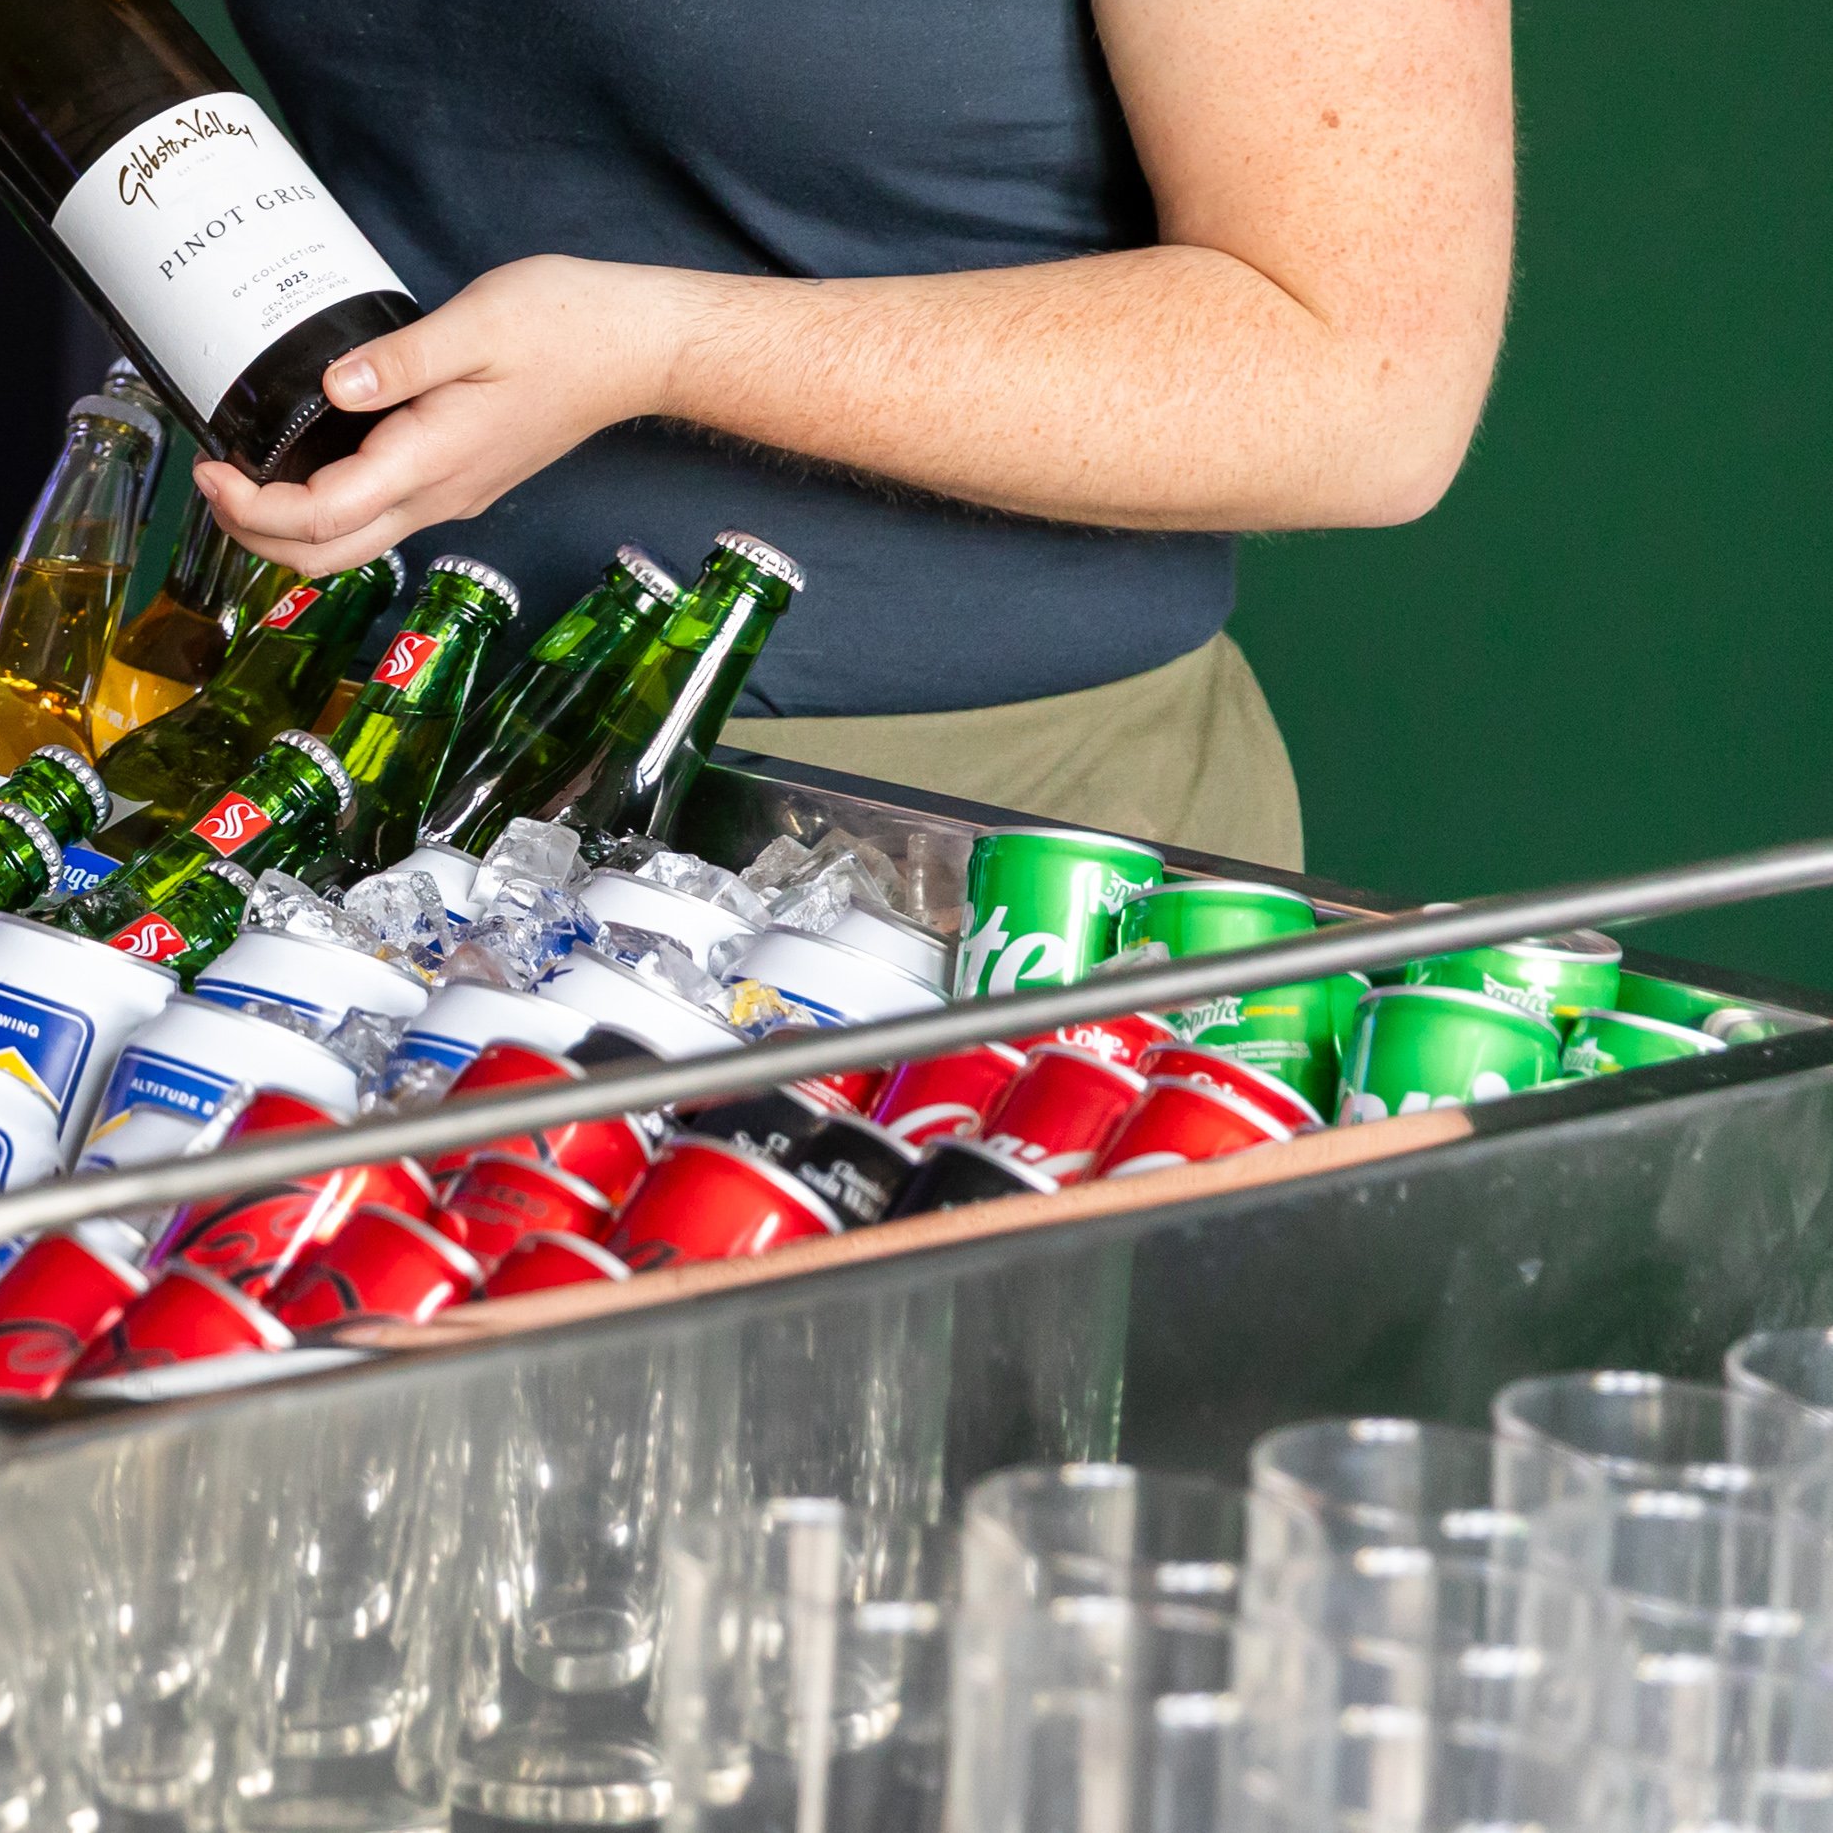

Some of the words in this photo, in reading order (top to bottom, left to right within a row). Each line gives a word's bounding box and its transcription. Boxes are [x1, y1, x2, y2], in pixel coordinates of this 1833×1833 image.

[175, 108, 260, 150] Valley
[158, 205, 246, 282] PINOT
[255, 184, 317, 212] GRIS
[231, 282, 248, 299] GV
[251, 241, 326, 283] COLLECTION
[276, 269, 309, 293] 2025
[260, 310, 284, 331] NEW
[130, 1076, 200, 1110] ALTITUDE
